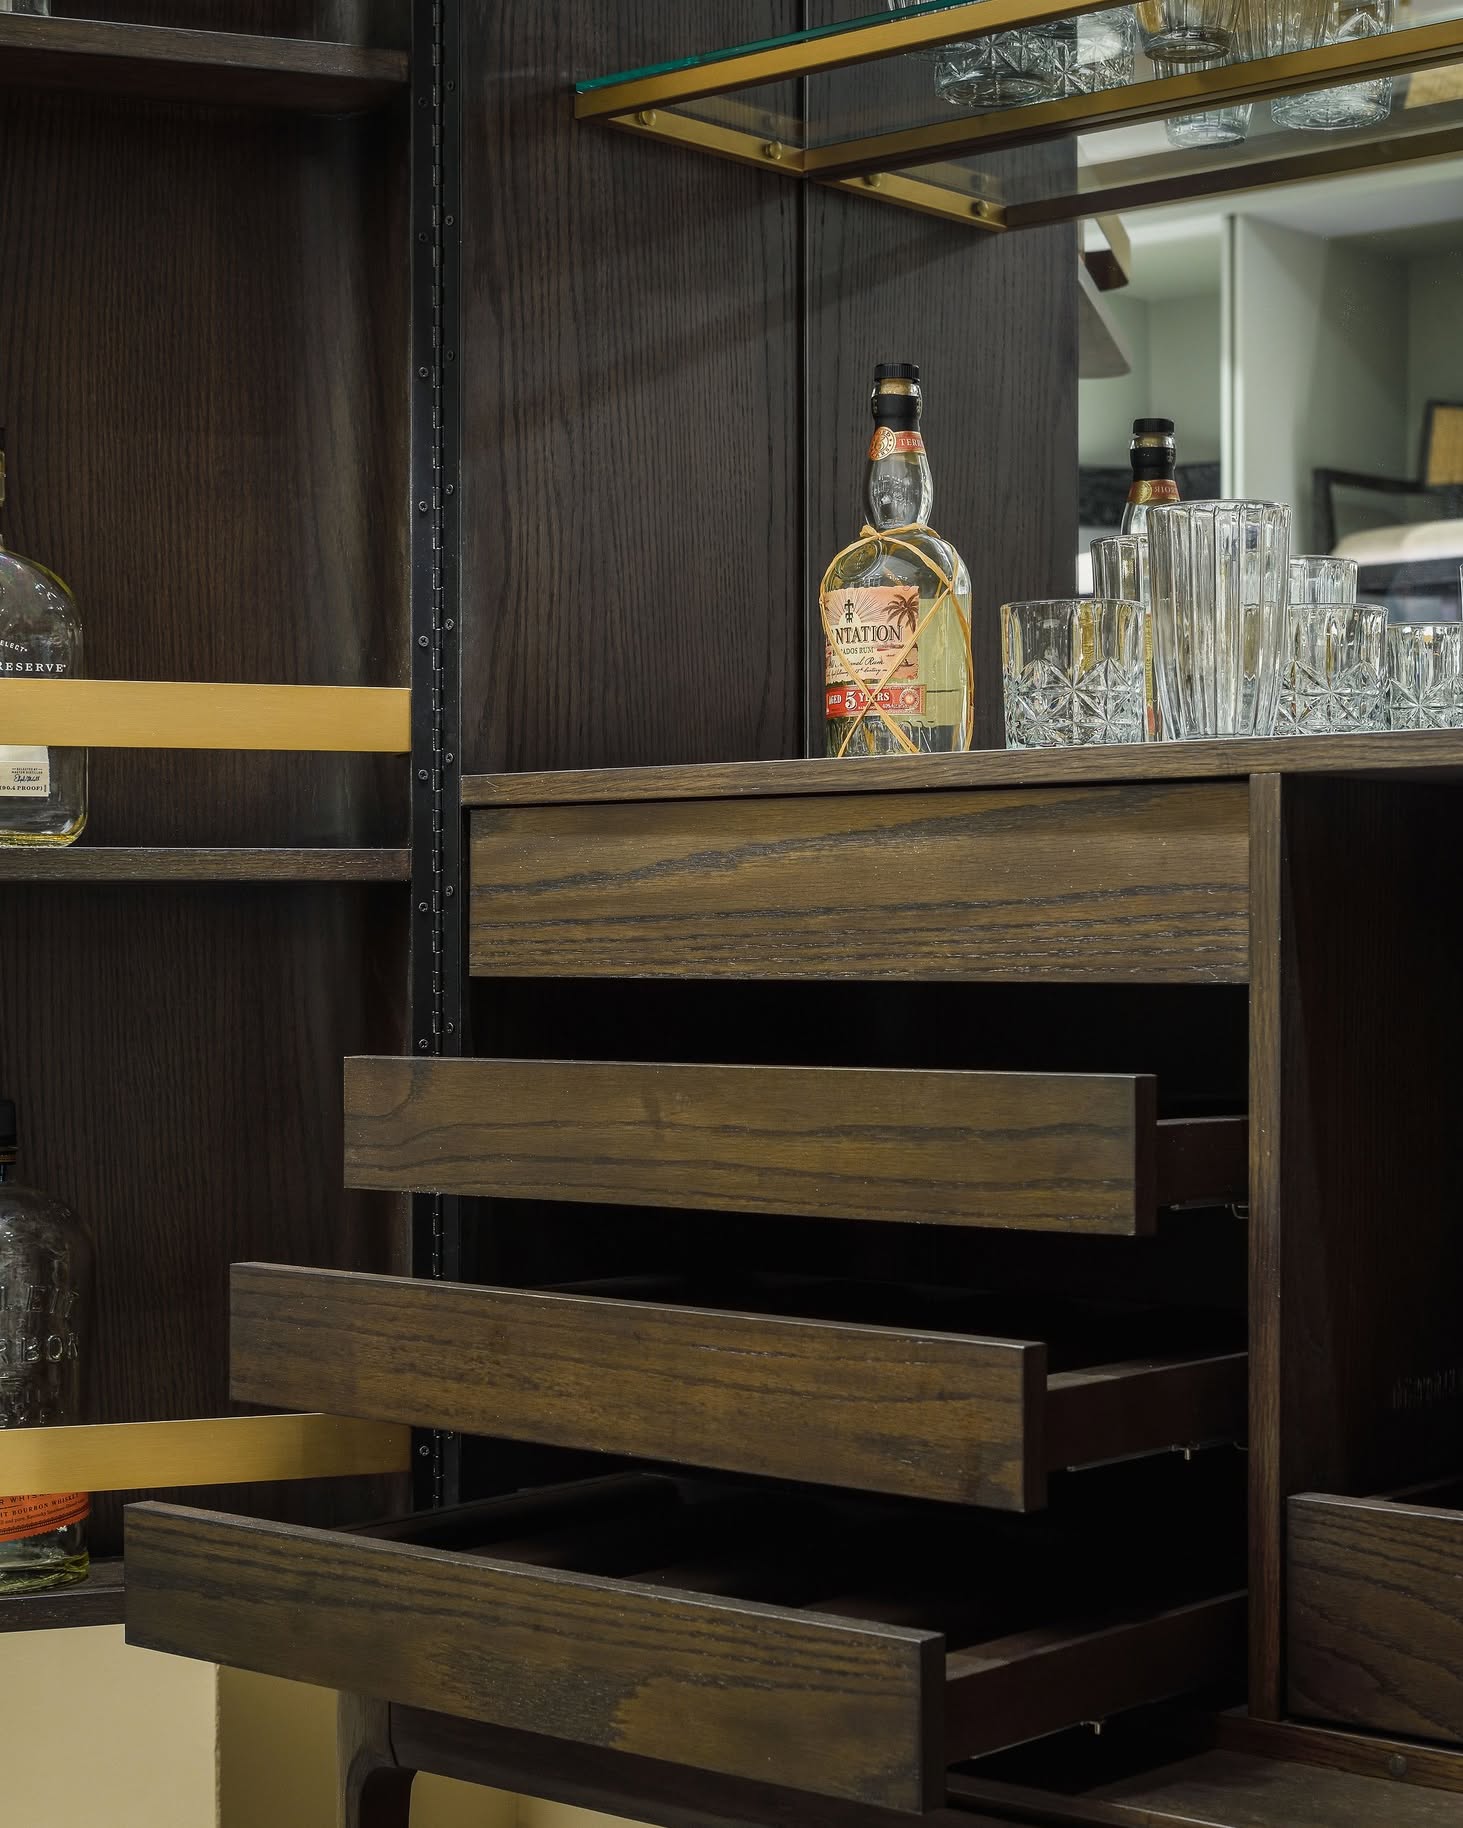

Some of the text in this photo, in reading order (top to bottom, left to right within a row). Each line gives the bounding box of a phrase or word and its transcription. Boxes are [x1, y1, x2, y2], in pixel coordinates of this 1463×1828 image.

[859, 646, 874, 654] RUM
[845, 690, 857, 711] 5
[12, 1502, 49, 1516] BOURBON
